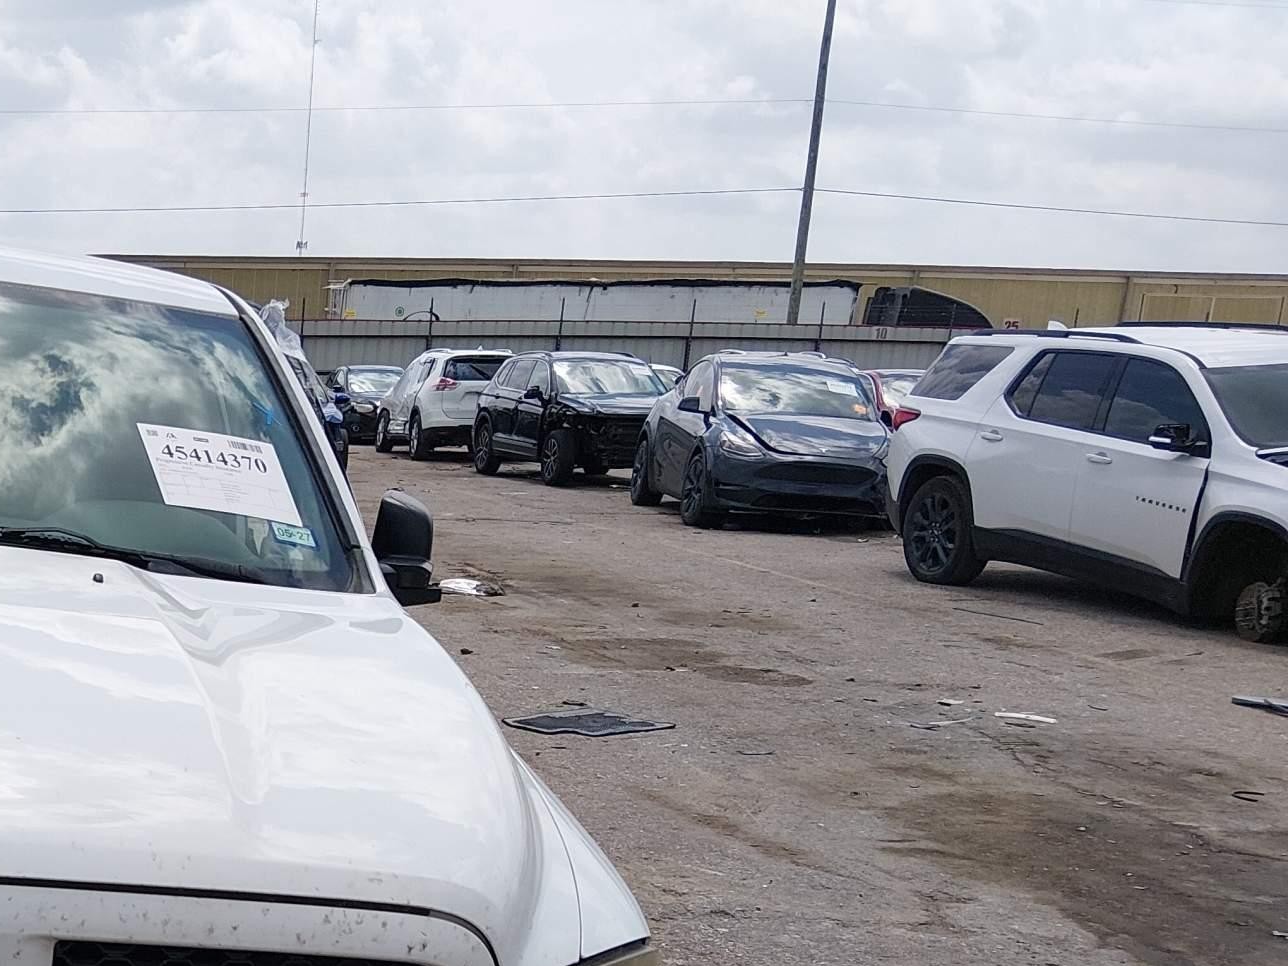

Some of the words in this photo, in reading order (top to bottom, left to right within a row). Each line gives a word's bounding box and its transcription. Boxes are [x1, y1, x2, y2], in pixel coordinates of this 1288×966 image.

[875, 327, 888, 339] 10
[161, 444, 267, 473] 45414370
[277, 527, 310, 542] 05-27
